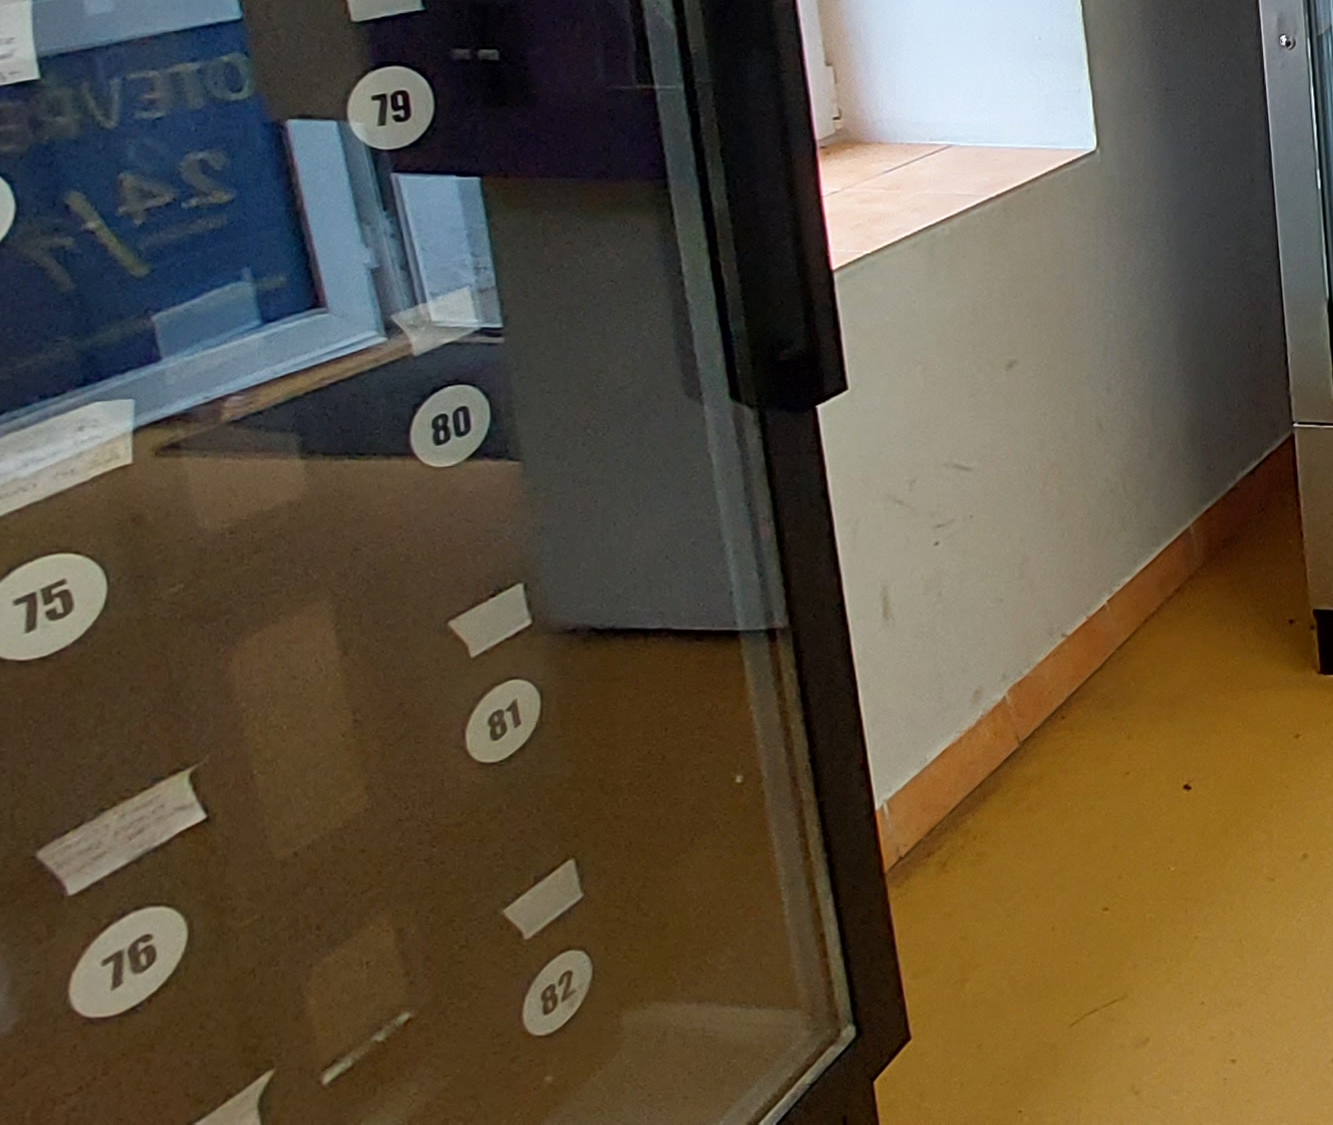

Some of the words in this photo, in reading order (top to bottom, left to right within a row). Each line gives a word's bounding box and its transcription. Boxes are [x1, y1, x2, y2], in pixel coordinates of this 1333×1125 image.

[370, 91, 411, 126] 79
[431, 405, 473, 444] 80
[13, 579, 74, 634] 75
[488, 701, 522, 740] 81
[102, 933, 157, 989] 76
[542, 972, 578, 1013] 82
